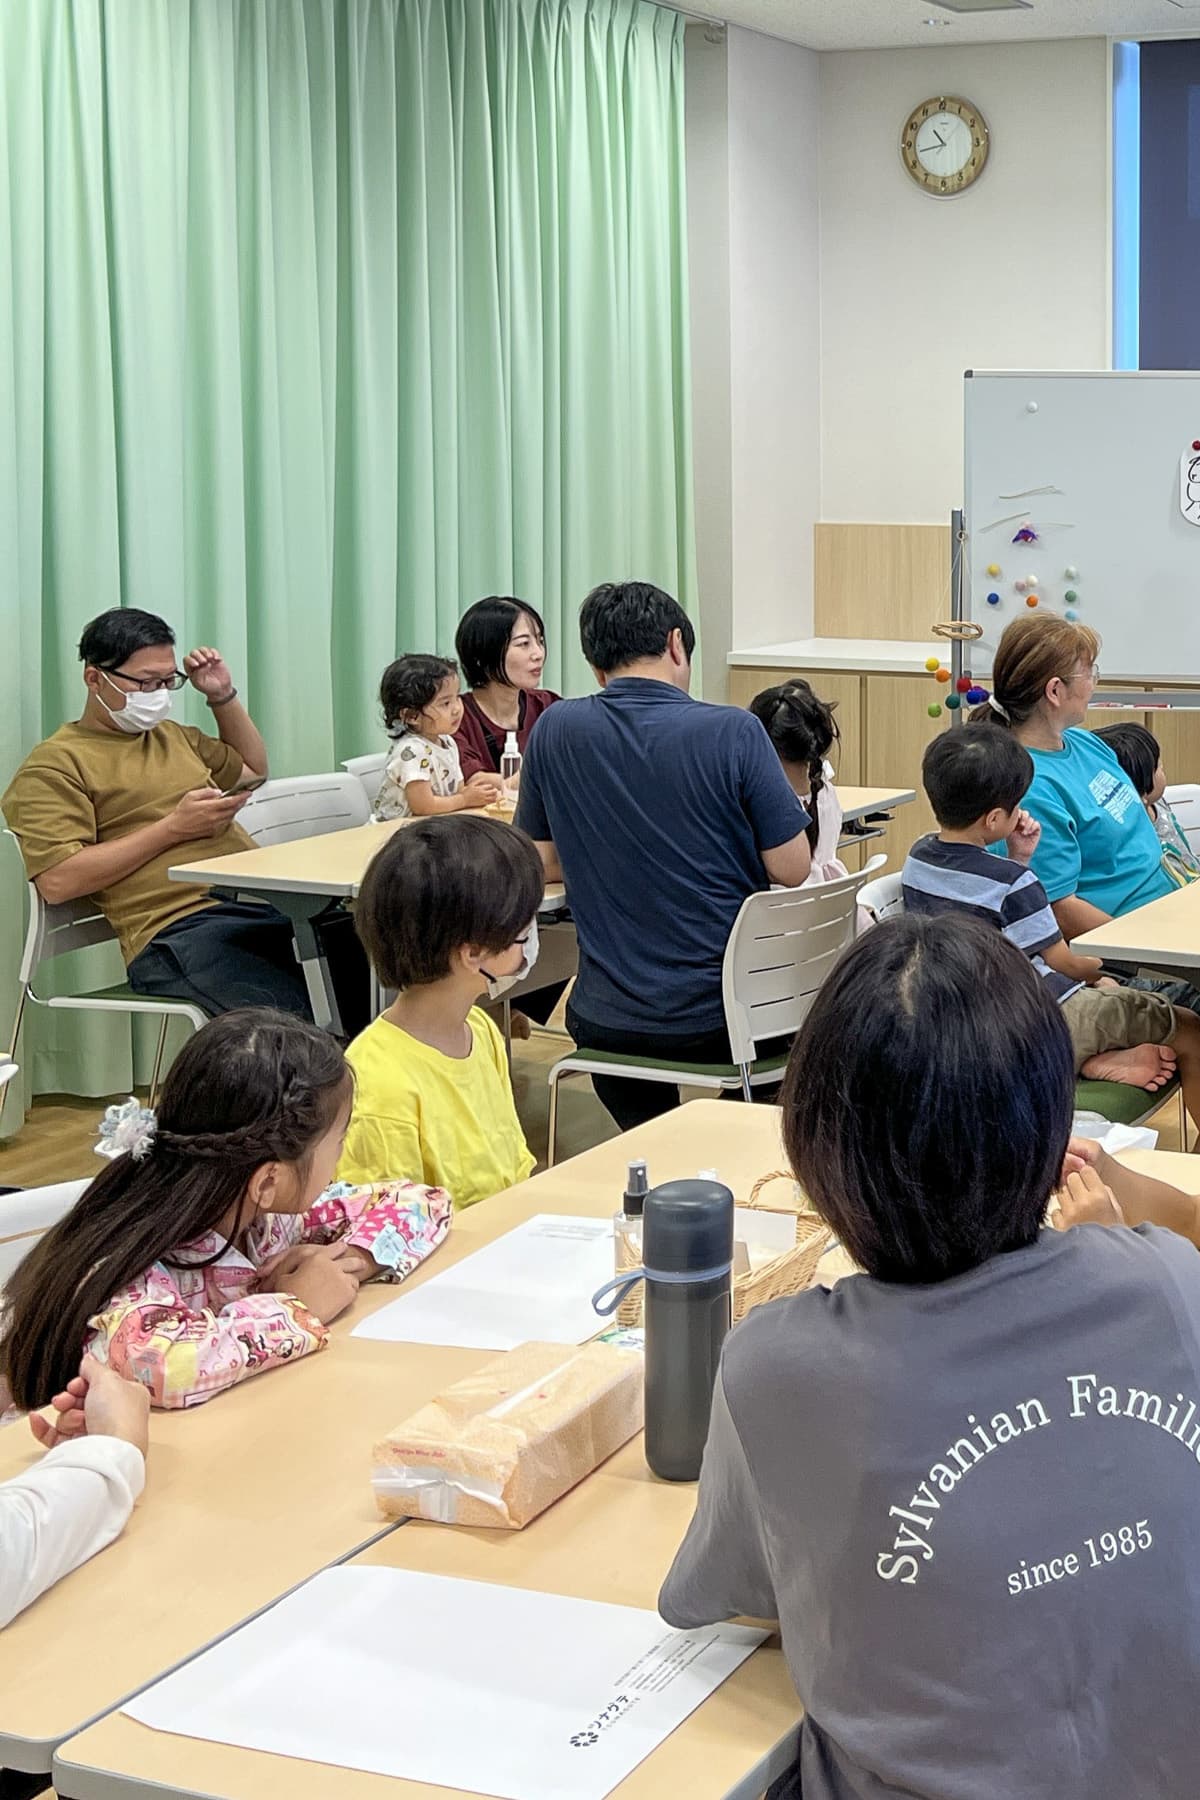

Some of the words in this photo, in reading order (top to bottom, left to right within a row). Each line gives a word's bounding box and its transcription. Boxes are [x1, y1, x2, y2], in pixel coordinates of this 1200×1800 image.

[969, 118, 976, 128] 2
[876, 1396, 1051, 1586] Sylvanian
[1006, 1549, 1080, 1595] since
[1083, 1519, 1154, 1570] 1985
